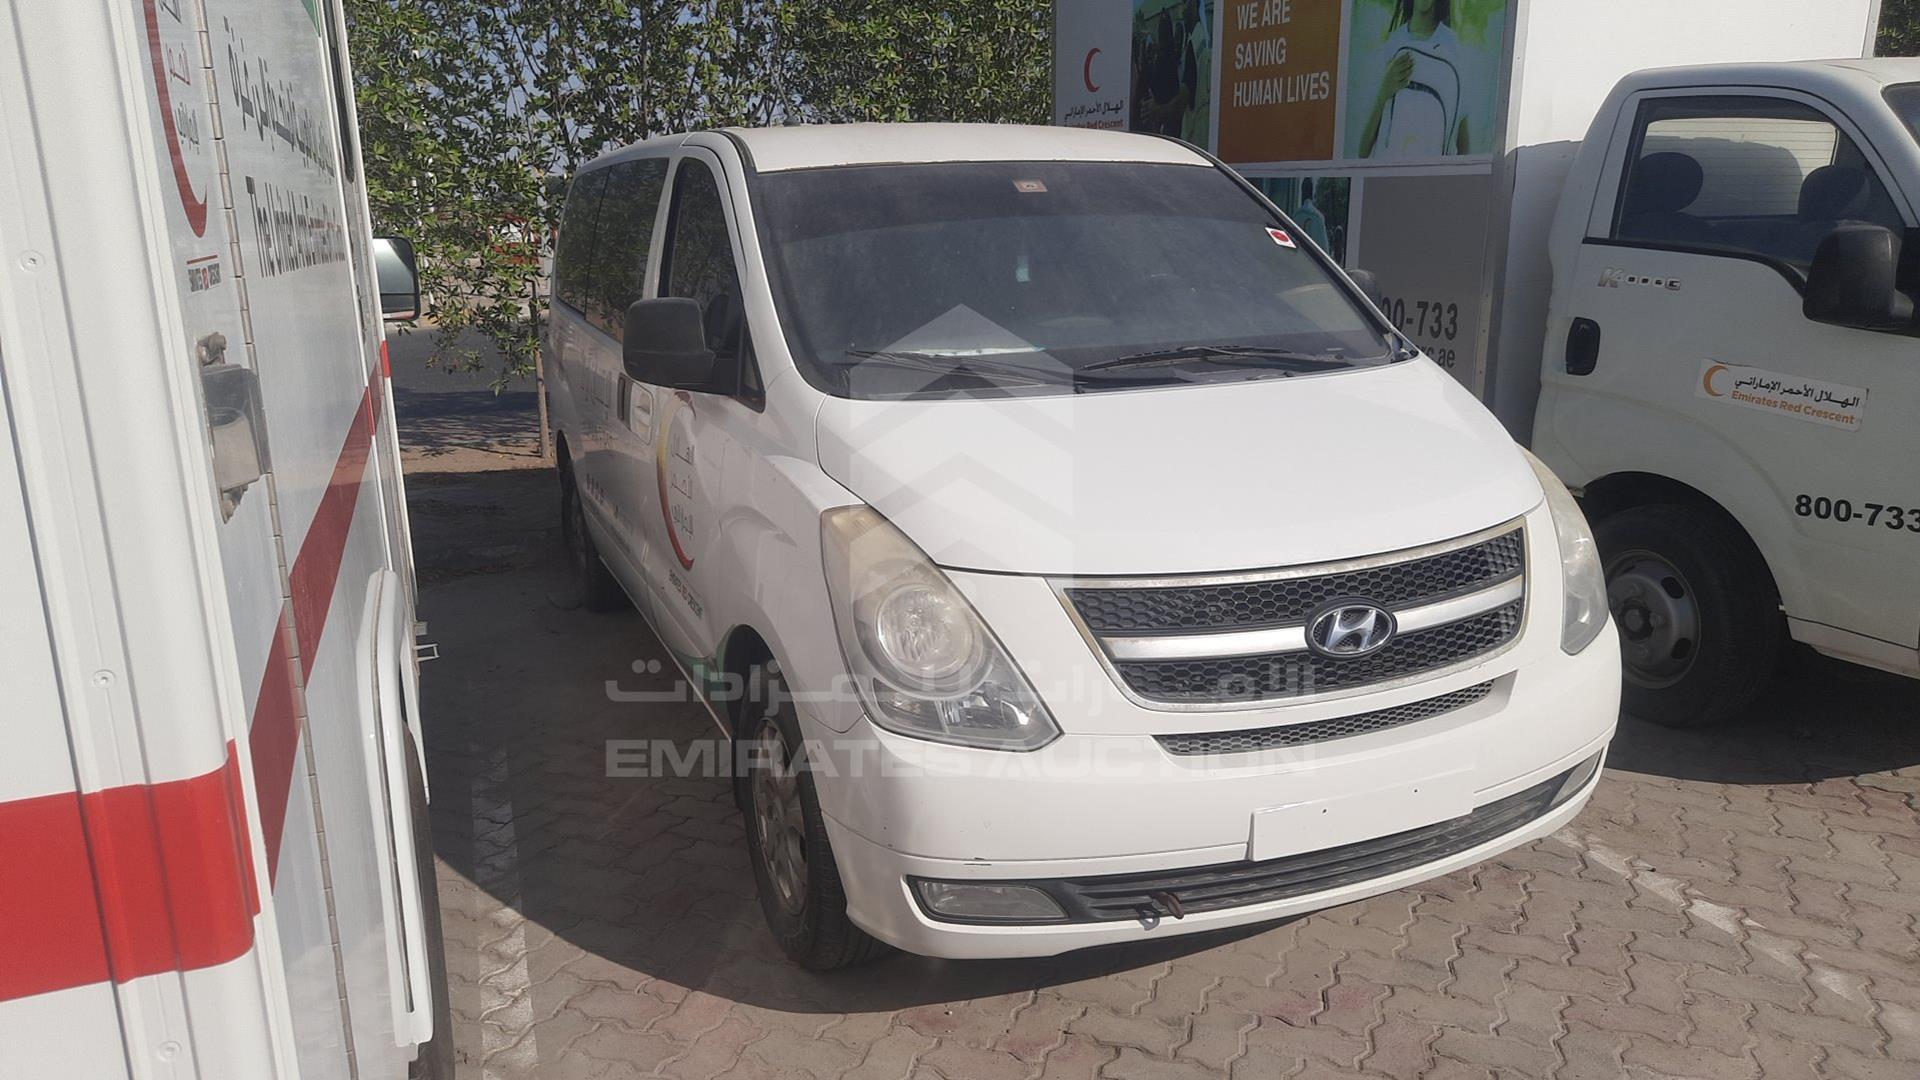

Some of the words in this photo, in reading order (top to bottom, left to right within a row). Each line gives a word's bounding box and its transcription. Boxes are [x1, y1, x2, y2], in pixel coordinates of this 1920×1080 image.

[1237, 2, 1258, 30] WE
[1261, 0, 1290, 27] ARE
[1235, 37, 1287, 70] SAVING
[1233, 77, 1283, 107] HUMAN
[1287, 71, 1329, 103] LIVES
[1382, 296, 1457, 341] 00-733
[1731, 390, 1778, 409] Emirates
[1779, 402, 1802, 413] Red
[1803, 406, 1856, 425] Crescent
[1795, 494, 1920, 533] 800-733
